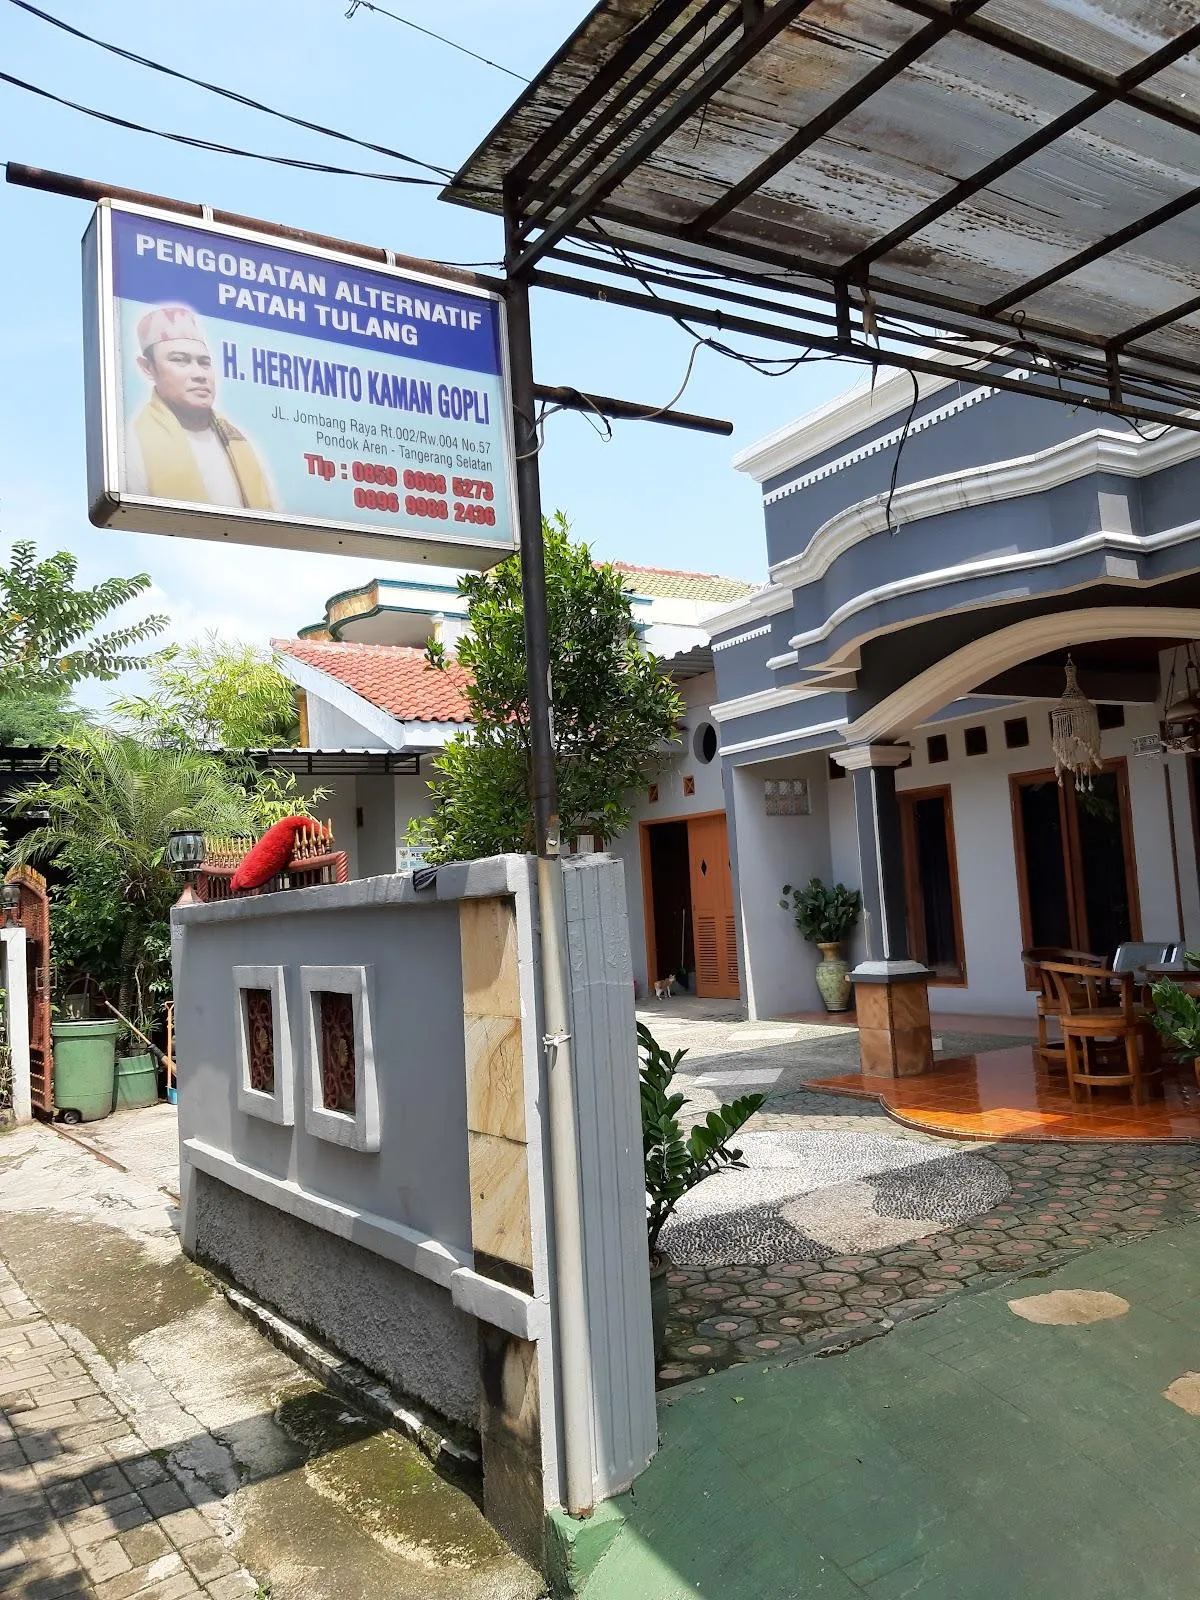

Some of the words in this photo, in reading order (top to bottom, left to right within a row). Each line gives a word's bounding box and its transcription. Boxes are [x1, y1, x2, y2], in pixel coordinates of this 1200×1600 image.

[136, 234, 326, 297] PENGOBATAN
[335, 281, 482, 331] ALTERNATIF
[218, 283, 306, 322] PATAH
[314, 305, 418, 346] TULANG
[222, 341, 245, 380] H.
[252, 347, 362, 402] HERIYANTO
[367, 370, 433, 415] KAMAN
[437, 384, 490, 425] GOPLI
[271, 405, 290, 421] JL.
[293, 409, 346, 433] Jombang
[350, 418, 377, 437] Raya
[380, 423, 458, 450] Rt.002/Rw.004
[461, 438, 491, 455] No.57
[316, 430, 359, 451] Pondok
[362, 439, 388, 456] Aren
[398, 444, 453, 469] Tangerang
[456, 454, 493, 472] Selatan
[452, 476, 495, 502] 5273
